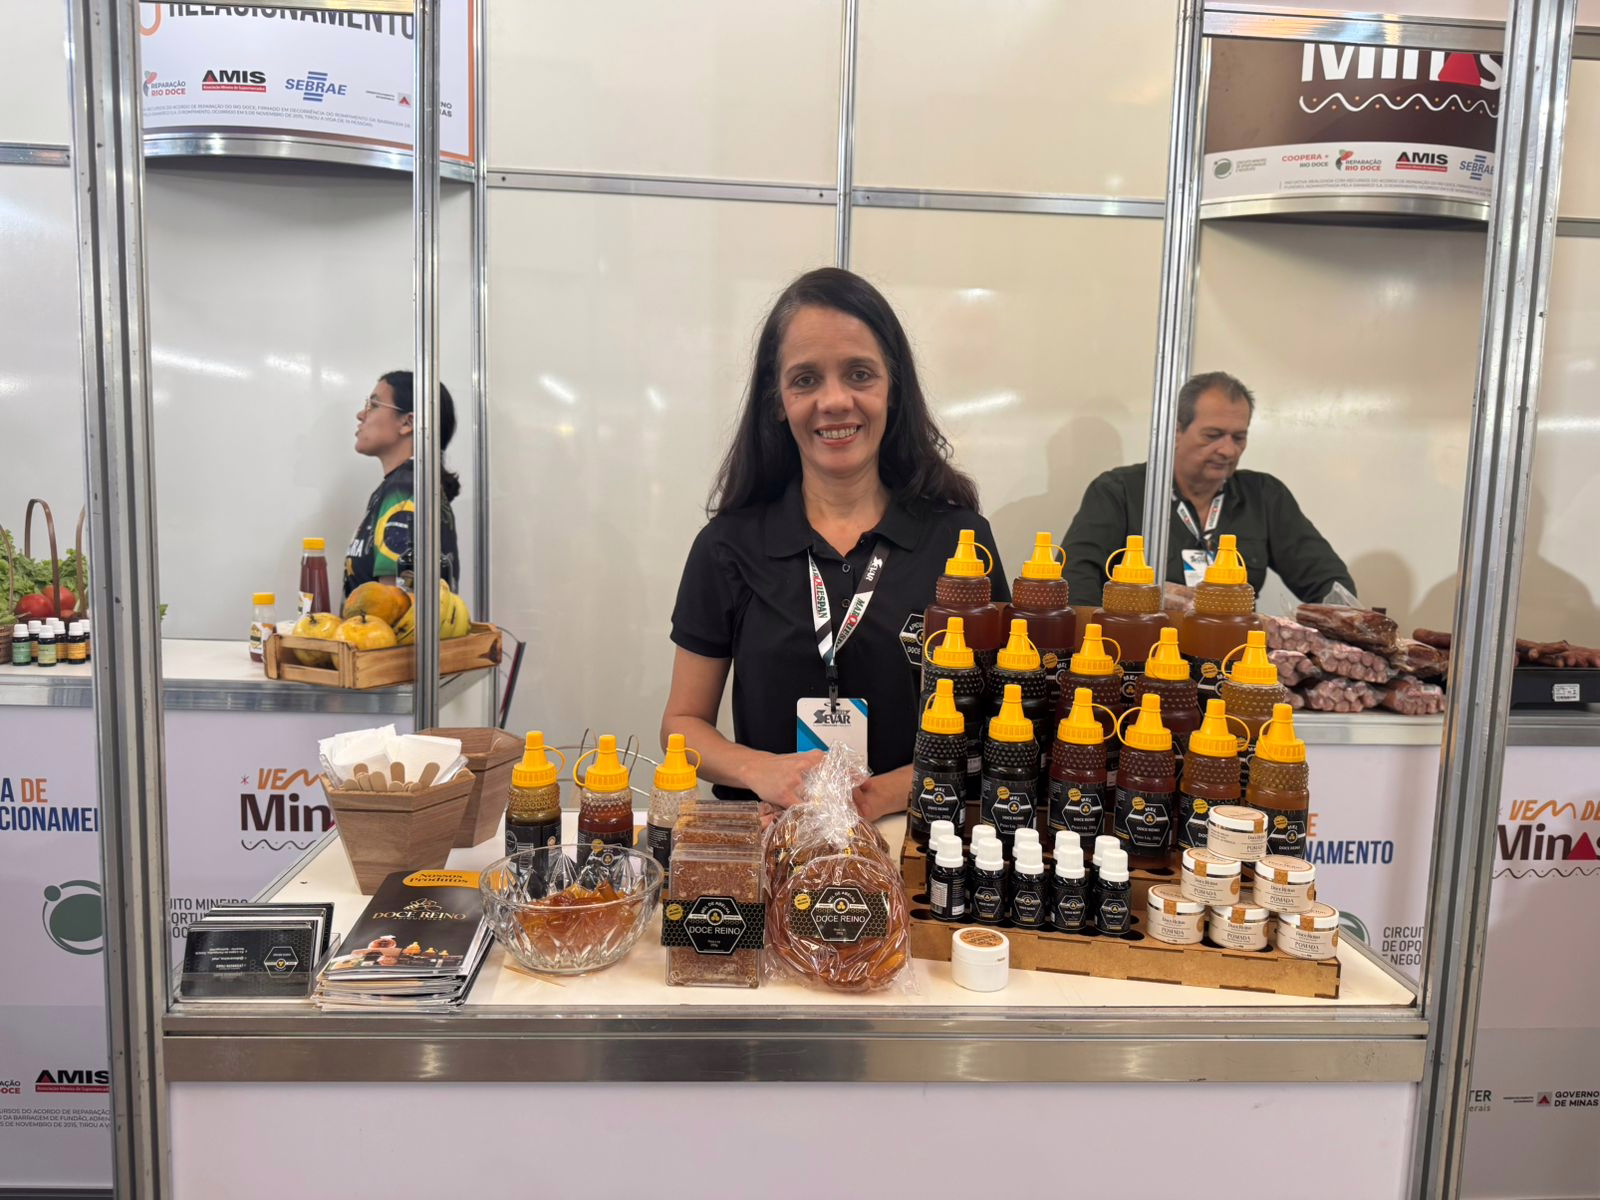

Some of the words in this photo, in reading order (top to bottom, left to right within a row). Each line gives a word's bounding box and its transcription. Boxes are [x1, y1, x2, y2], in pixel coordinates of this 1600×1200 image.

[202, 70, 266, 84] AMIS
[285, 78, 347, 96] SEBRAE
[1282, 154, 1322, 162] COOPERA
[1397, 152, 1448, 165] AMIS
[21, 778, 48, 803] DE
[241, 792, 335, 832] Min
[1510, 800, 1576, 820] VEM
[1497, 823, 1600, 860] Mina
[715, 927, 740, 935] REINO
[1383, 940, 1396, 952] DE
[36, 1070, 109, 1084] AMIS
